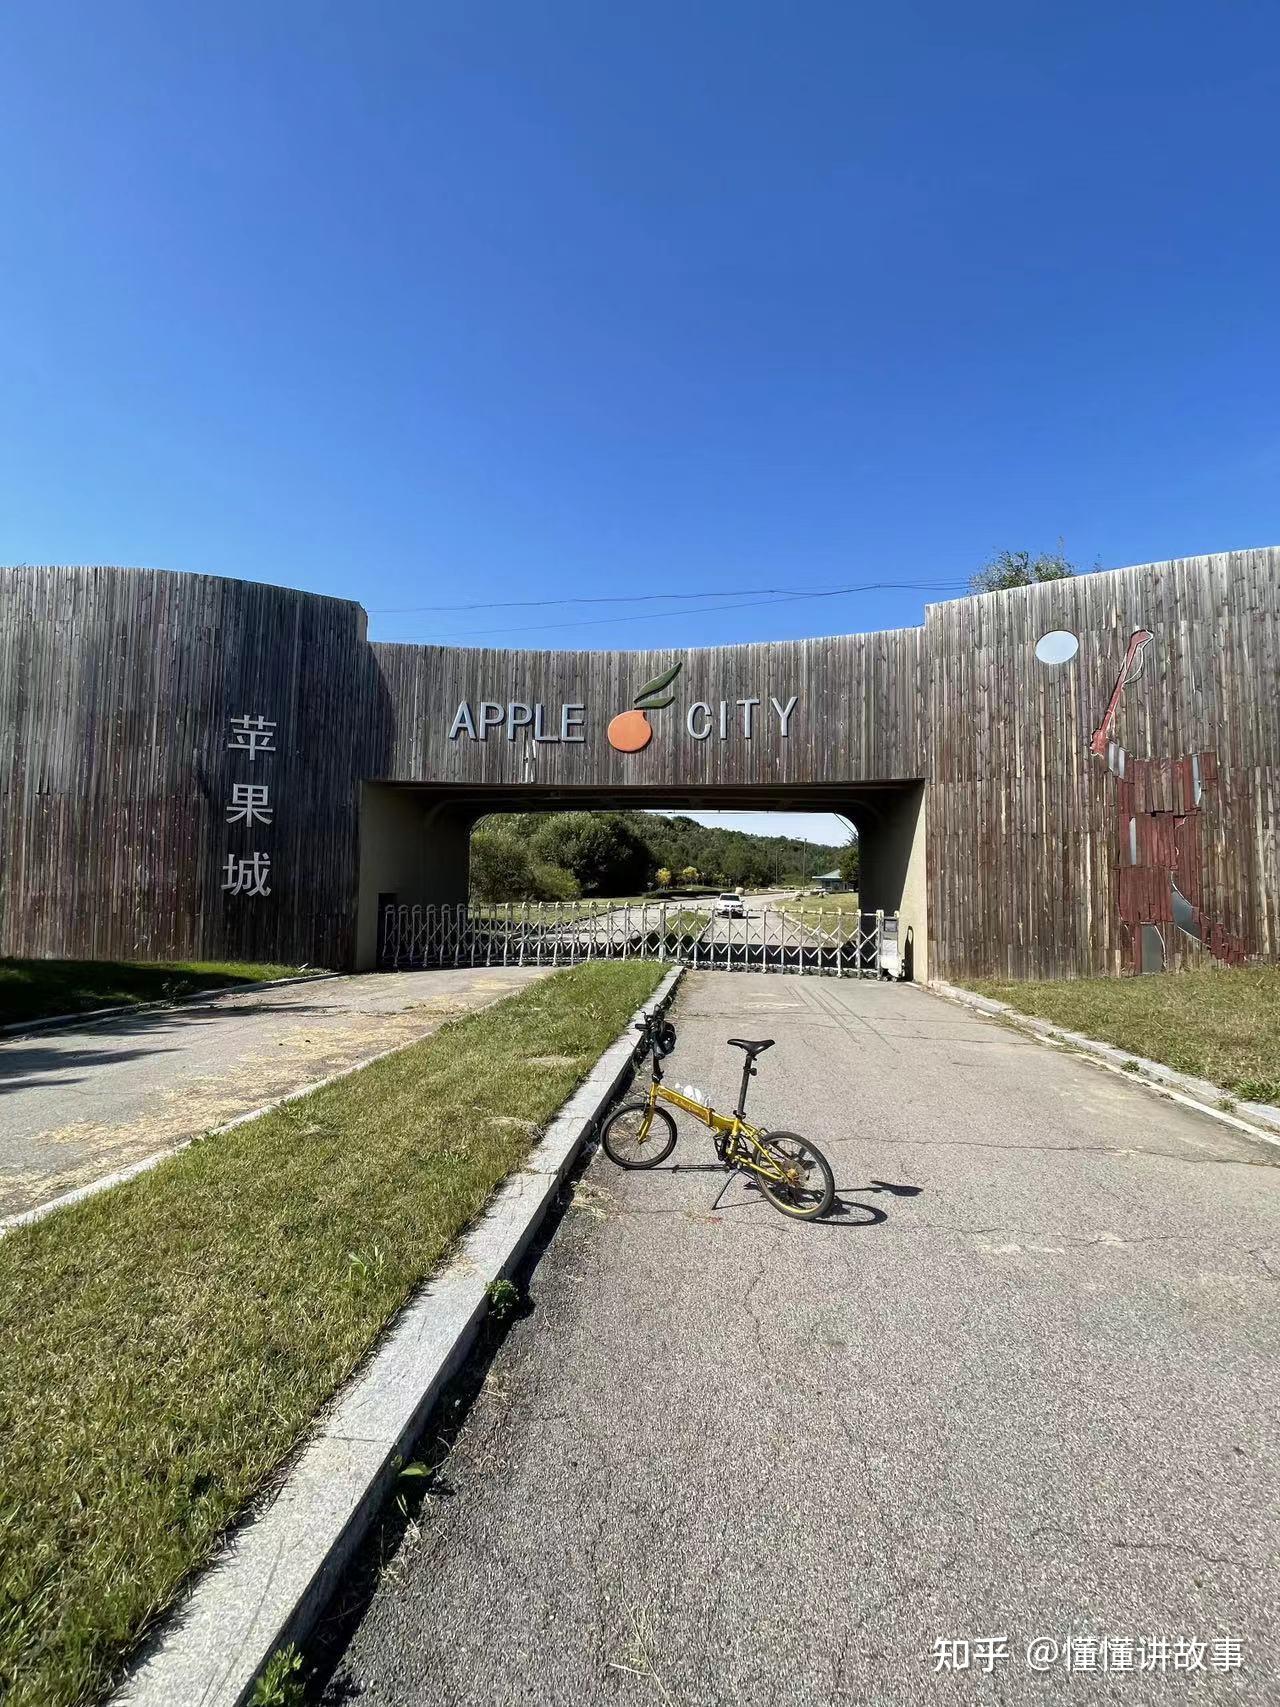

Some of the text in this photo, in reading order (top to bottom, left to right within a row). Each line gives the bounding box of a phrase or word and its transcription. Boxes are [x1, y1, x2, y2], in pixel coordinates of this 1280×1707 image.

[449, 696, 798, 742] APPLE CITY
[220, 714, 277, 897] 苹果城
